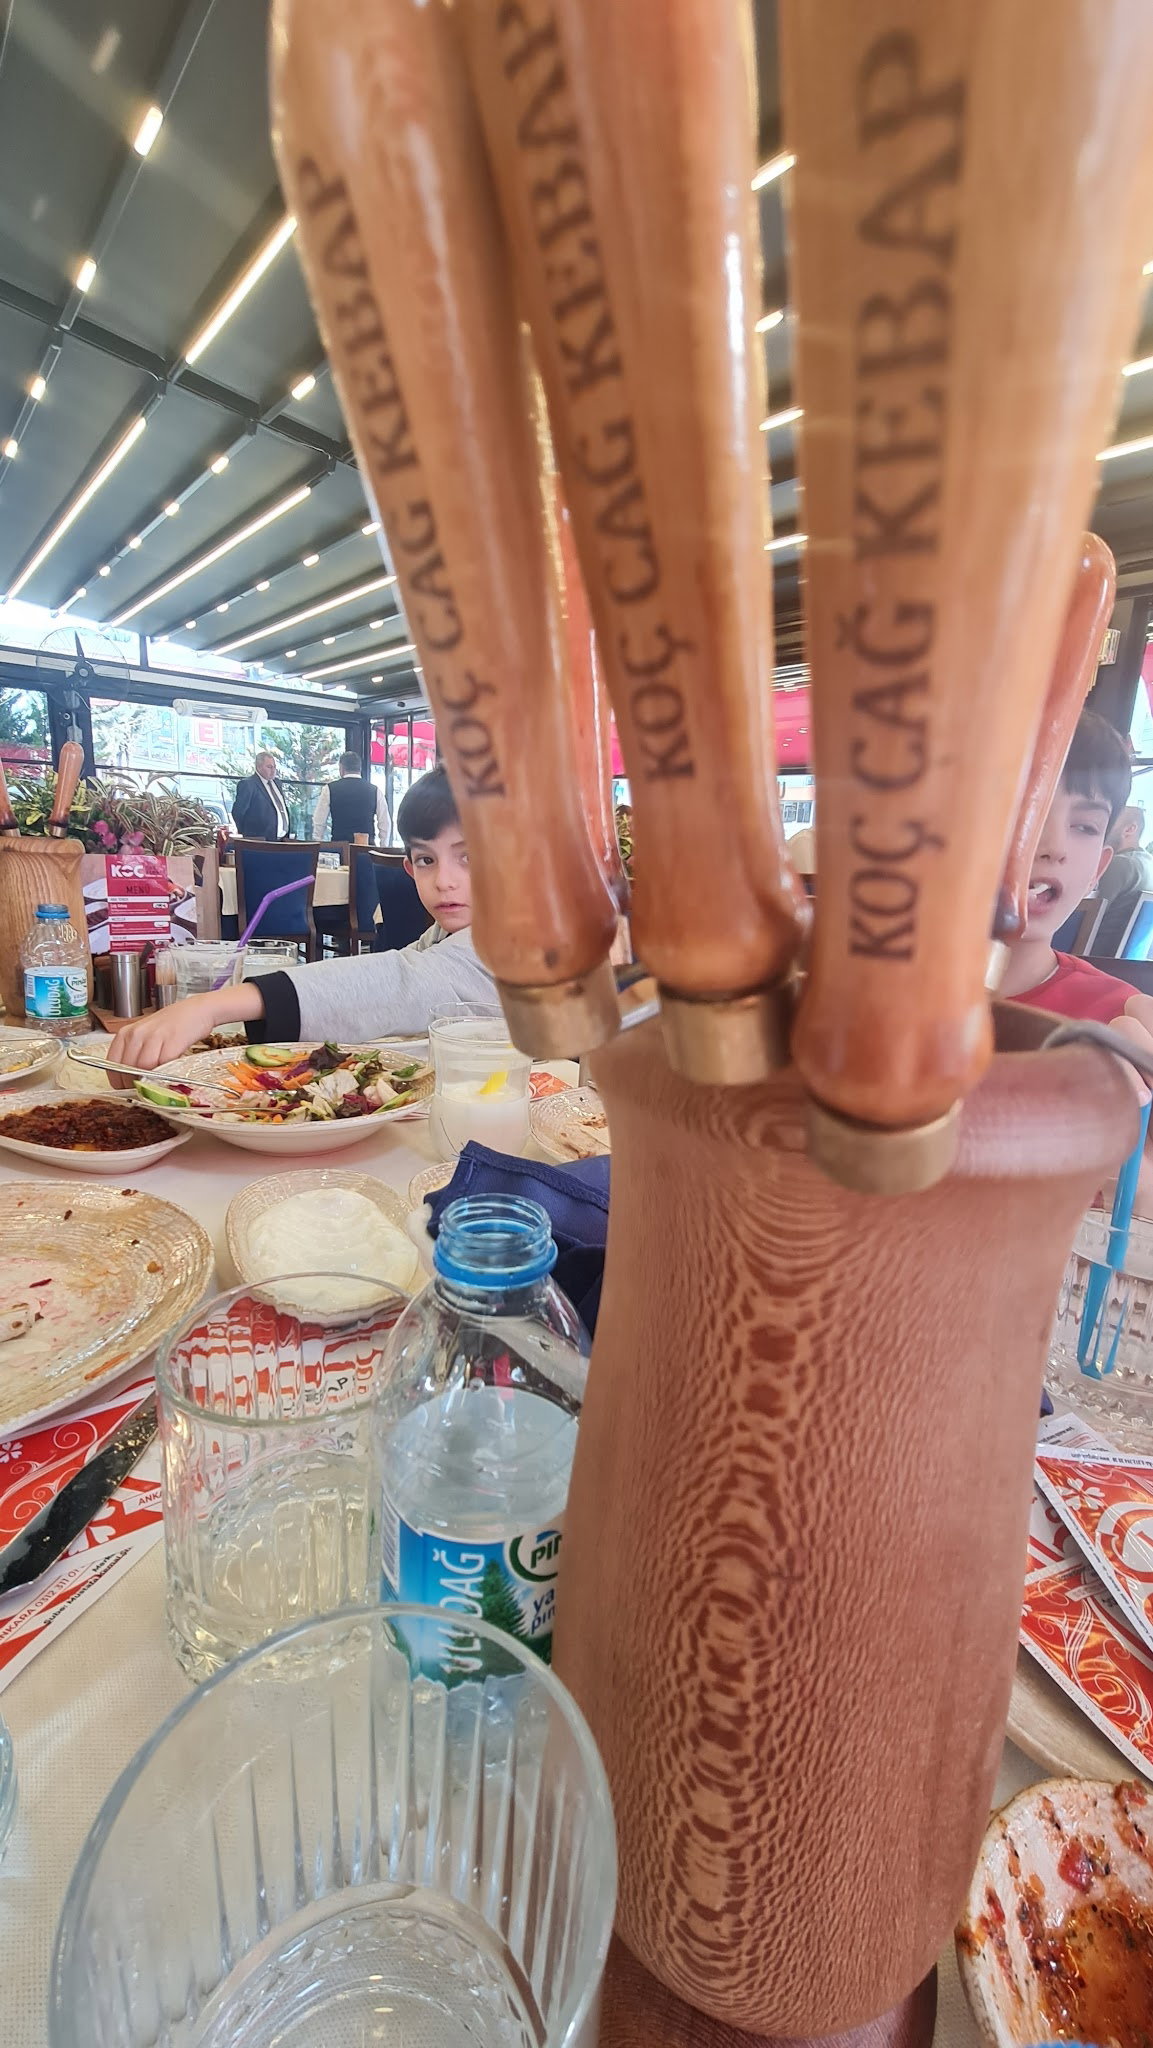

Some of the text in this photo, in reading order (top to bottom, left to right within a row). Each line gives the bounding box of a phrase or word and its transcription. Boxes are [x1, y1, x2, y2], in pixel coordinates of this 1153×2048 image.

[298, 154, 420, 479] KEBAP
[854, 28, 968, 564] KEBAP
[199, 723, 215, 742] E
[434, 668, 506, 799] KOÇ
[619, 622, 697, 786] KOÇ
[849, 814, 946, 963] KOÇ
[45, 979, 62, 1016] ULUDAĞ
[0, 1608, 36, 1641] NKARA
